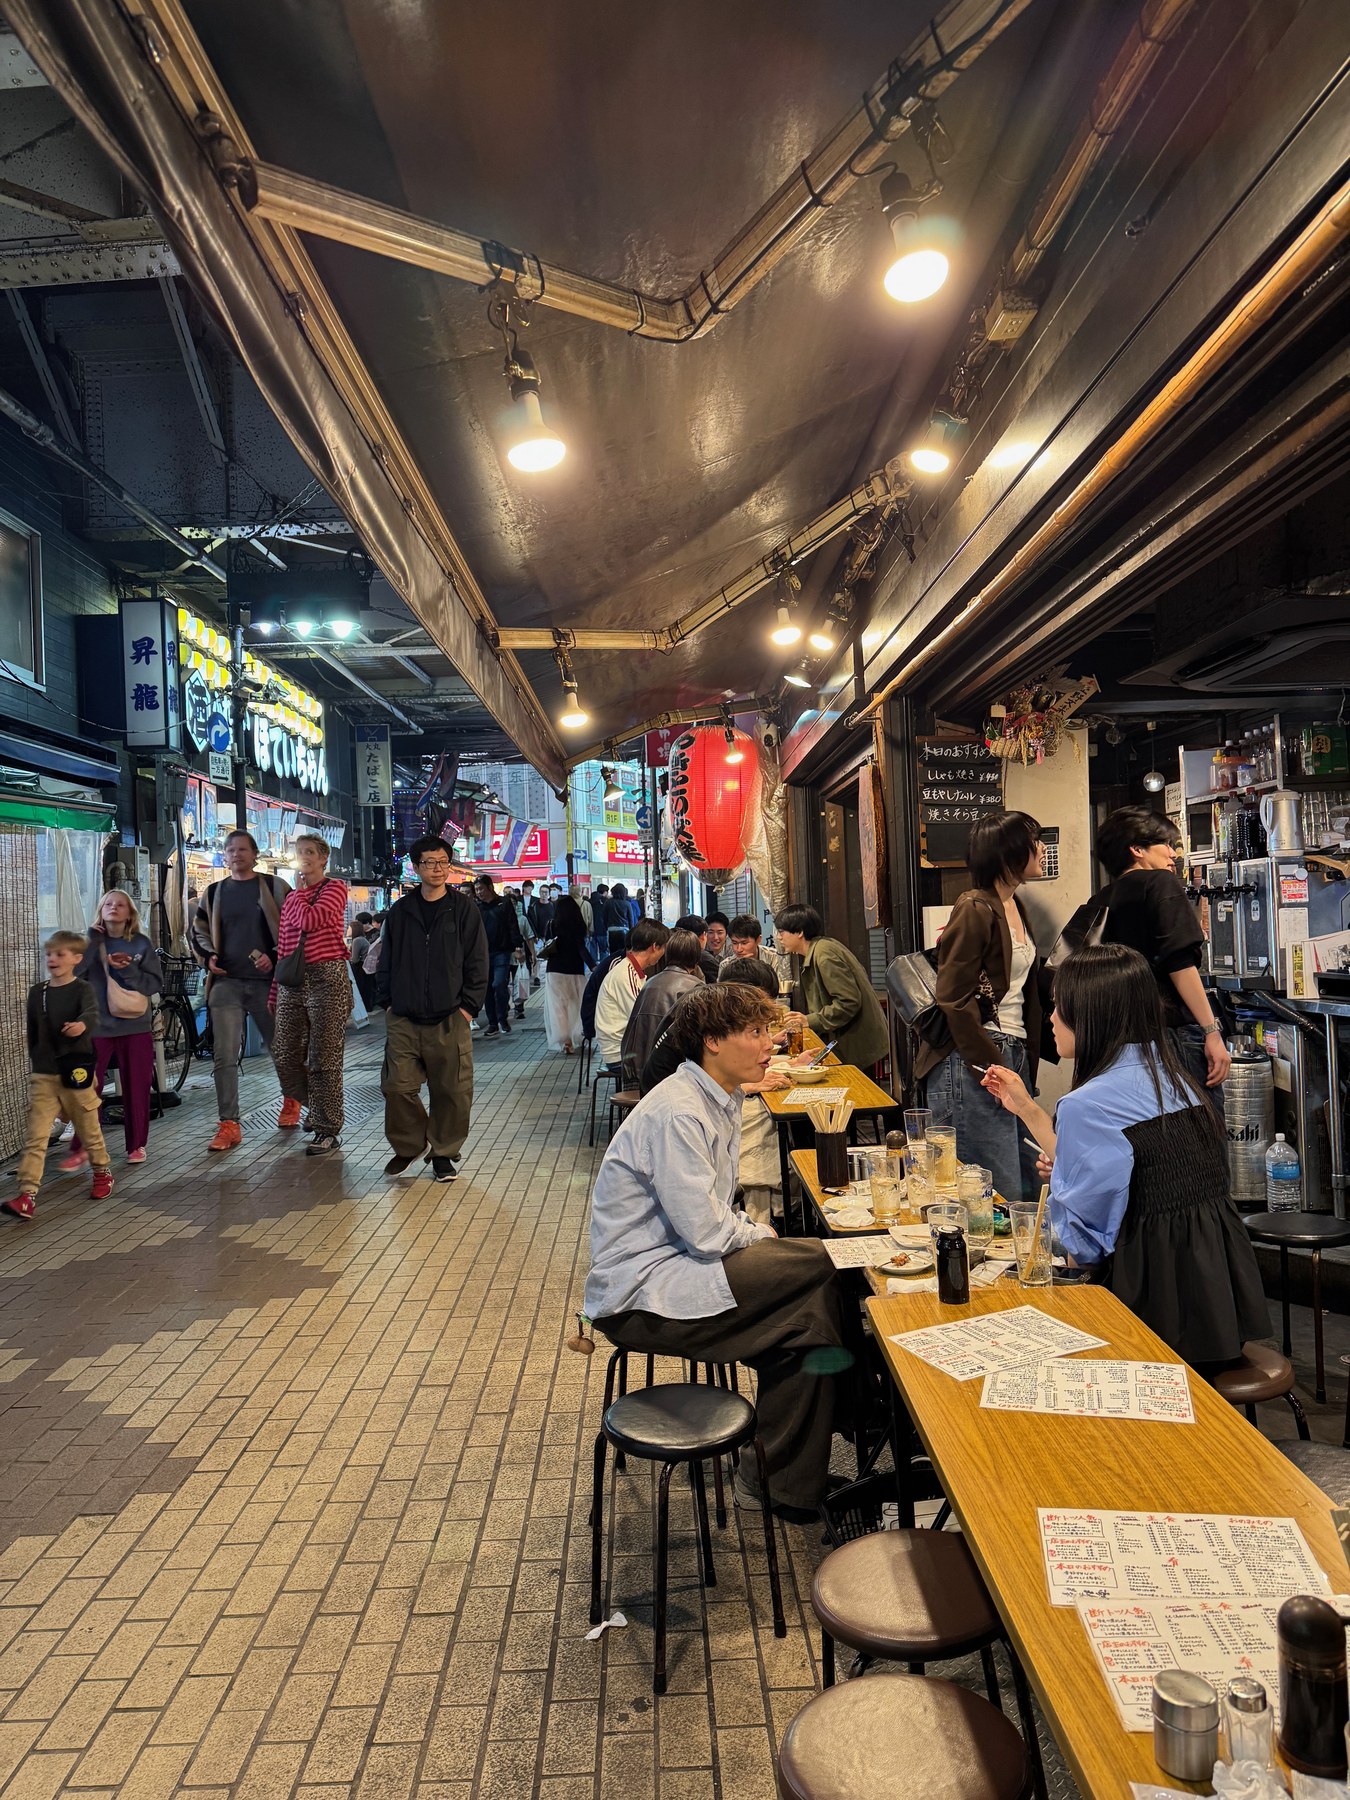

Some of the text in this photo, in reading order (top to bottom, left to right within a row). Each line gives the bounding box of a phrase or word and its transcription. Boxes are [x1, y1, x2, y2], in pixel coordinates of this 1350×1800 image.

[130, 636, 160, 712] 昇龍
[167, 641, 178, 713] 昇龍
[254, 714, 329, 797] ほていちゃん
[919, 741, 992, 761] 本日のおすすめ
[211, 766, 230, 775] 一方通行
[367, 752, 381, 803] たばこ店
[928, 769, 974, 781] ししゃも焼き
[922, 787, 1002, 804] 豆もやしナムル ¥380
[606, 813, 618, 823] B1F
[927, 808, 980, 821] 焼きそら豆
